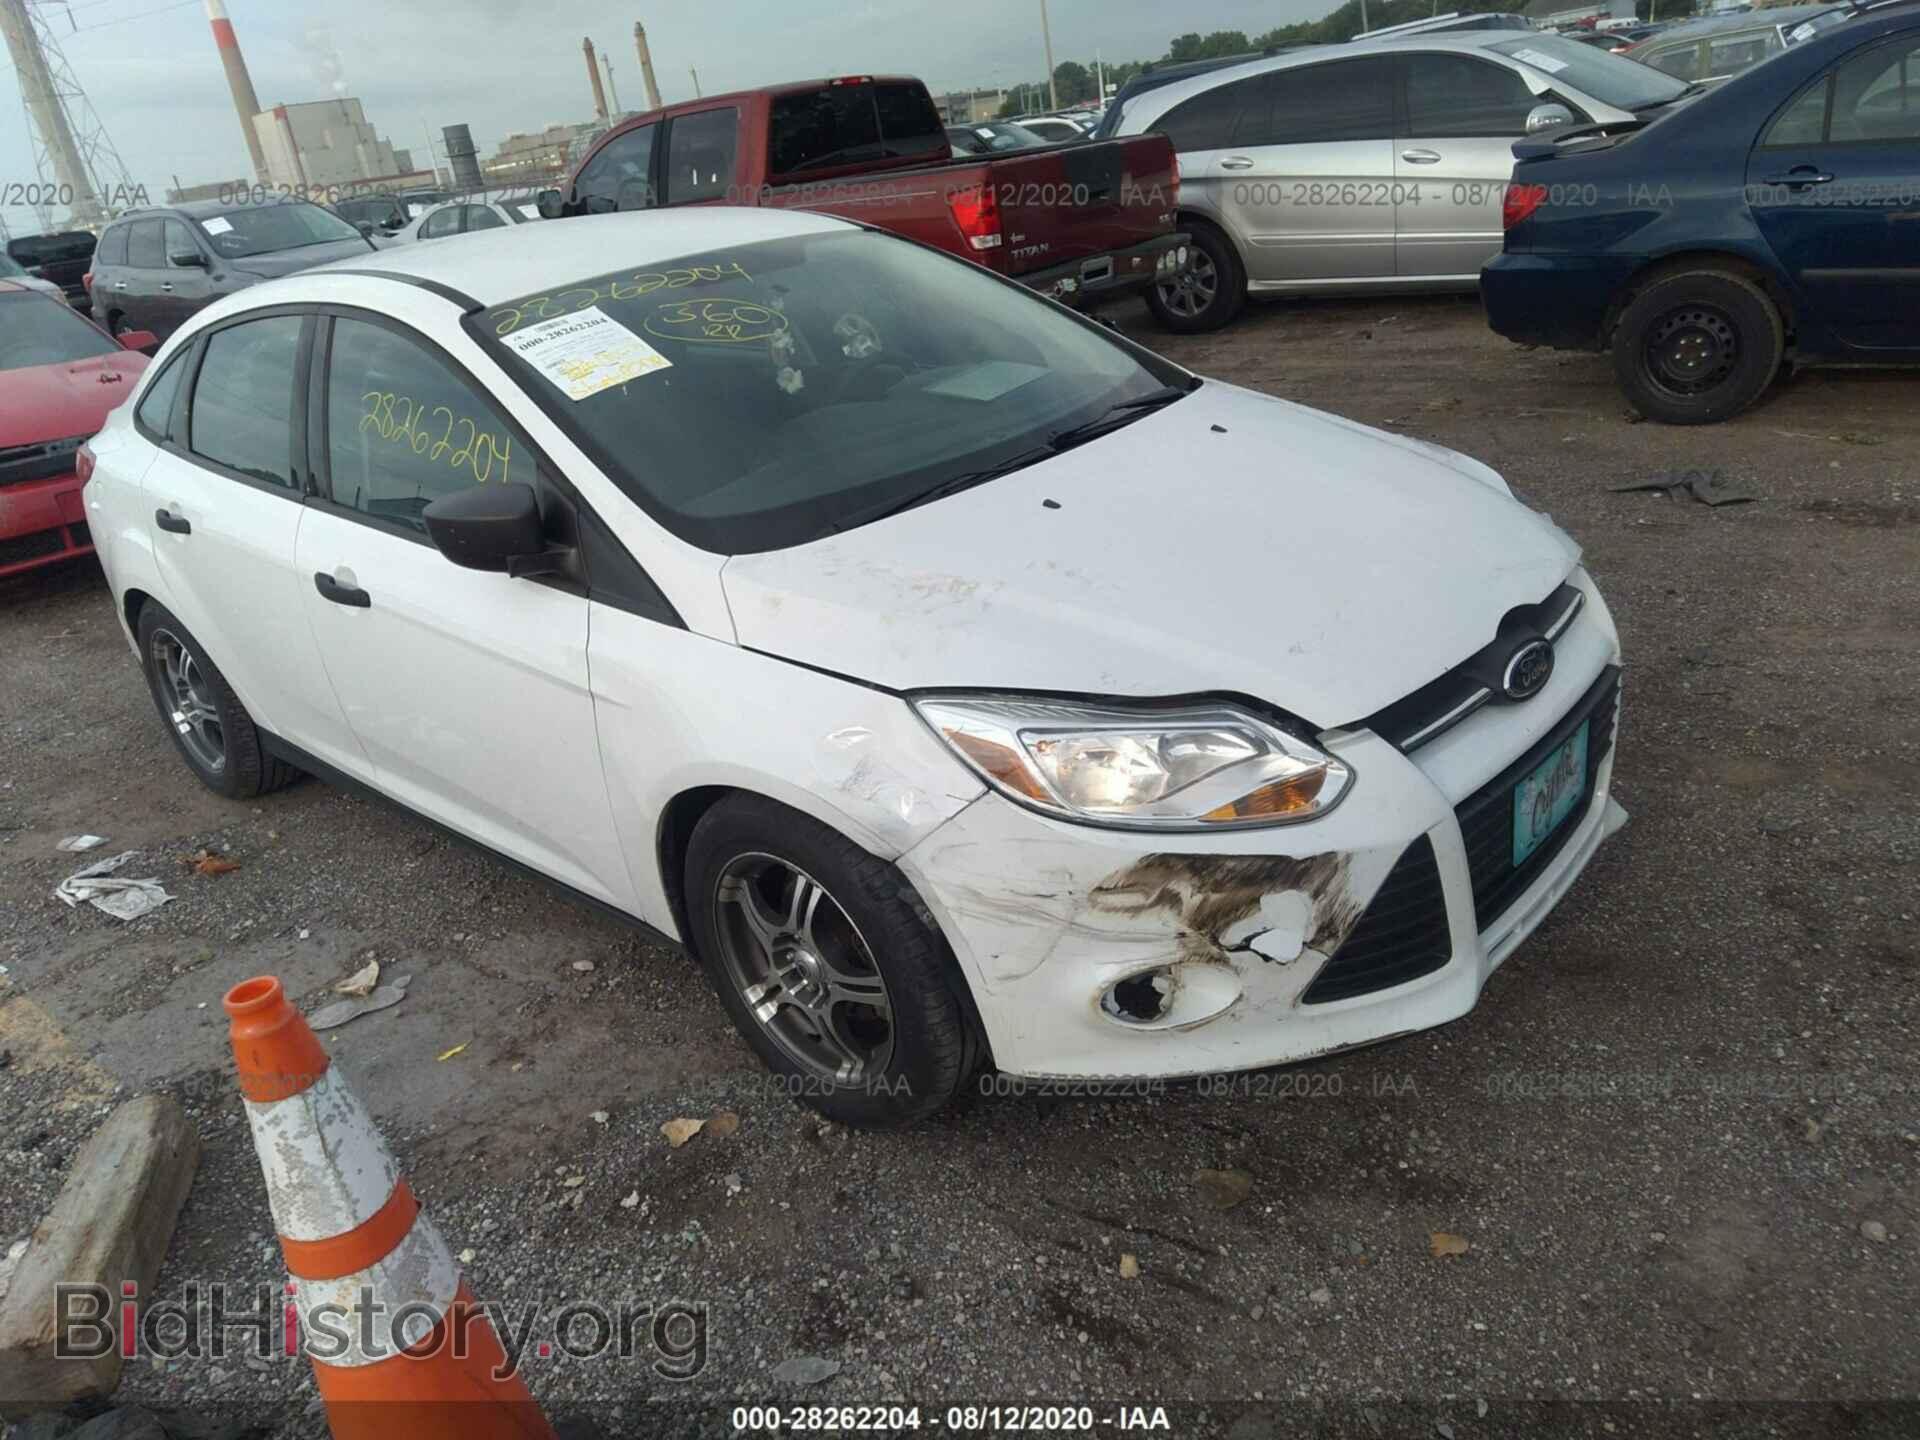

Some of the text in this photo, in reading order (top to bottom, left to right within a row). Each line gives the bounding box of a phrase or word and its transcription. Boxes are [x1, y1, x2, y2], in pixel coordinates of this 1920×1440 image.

[1011, 243, 1050, 259] TITAN
[658, 302, 770, 324] 360
[518, 317, 609, 351] 000-28262204
[359, 391, 511, 483] 28262204
